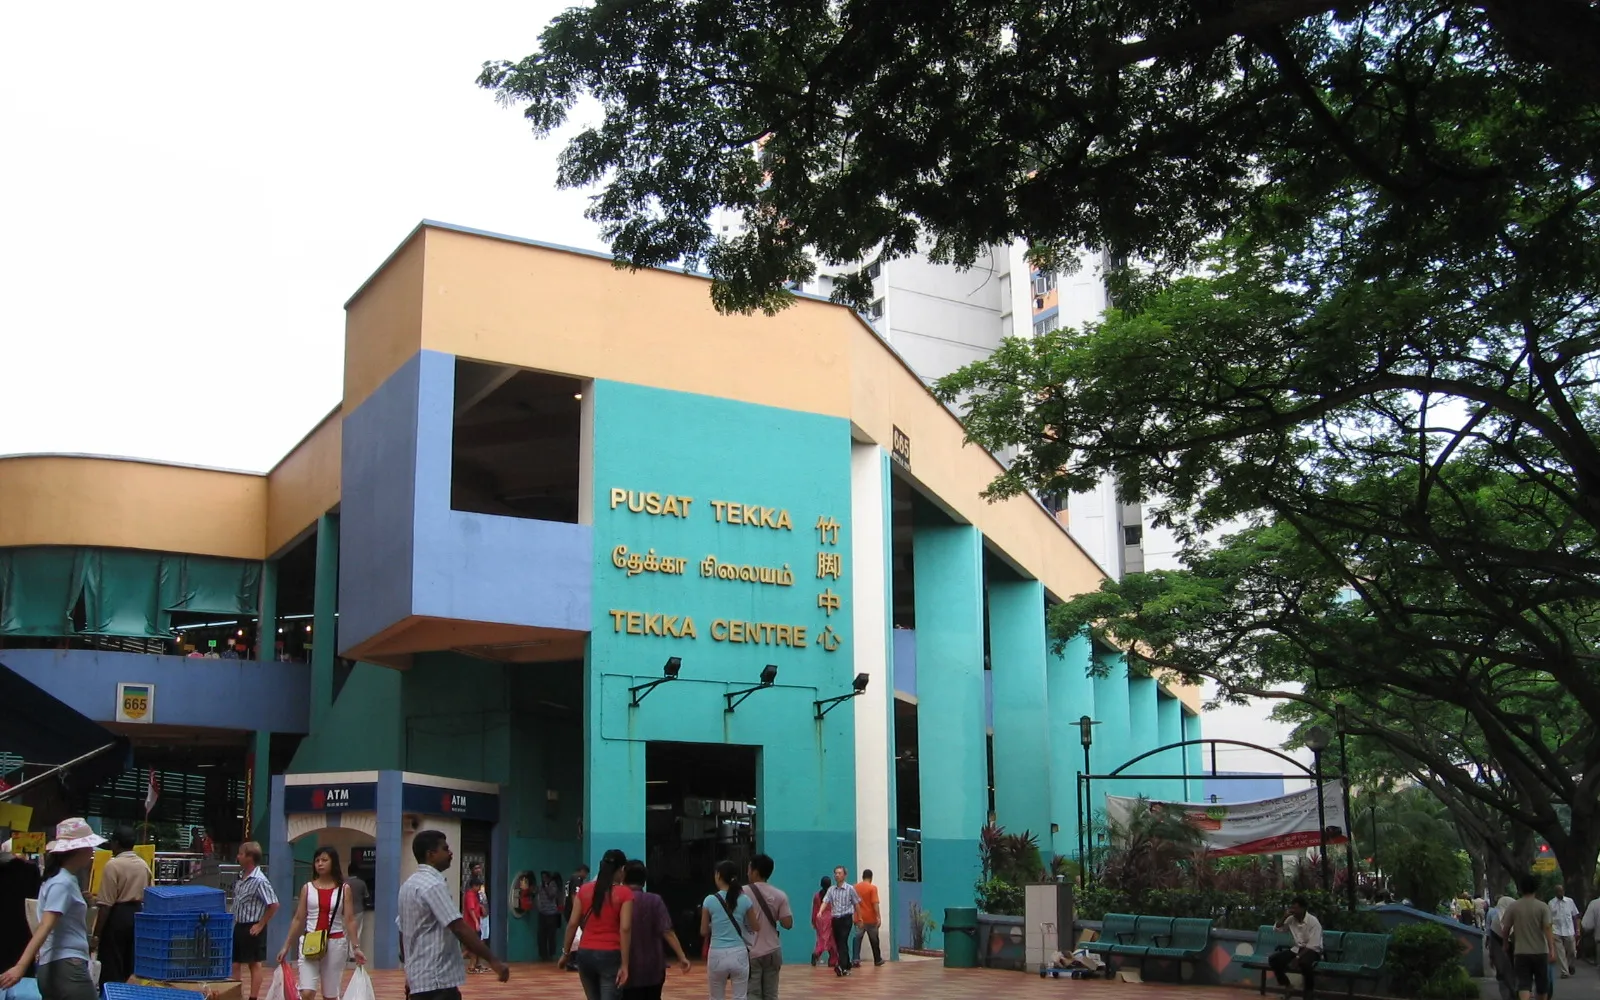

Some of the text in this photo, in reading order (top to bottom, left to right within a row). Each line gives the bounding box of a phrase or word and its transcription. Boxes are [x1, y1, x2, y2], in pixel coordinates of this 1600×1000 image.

[894, 430, 909, 459] 665
[610, 488, 792, 530] PUSAT TEKKA
[612, 545, 795, 586] தேக்கா நிலையம்
[815, 516, 841, 651] 竹脚中心
[609, 609, 807, 647] TEKKA CENTRE
[124, 698, 147, 710] 665
[326, 789, 349, 801] ATM
[451, 794, 467, 807] ATM
